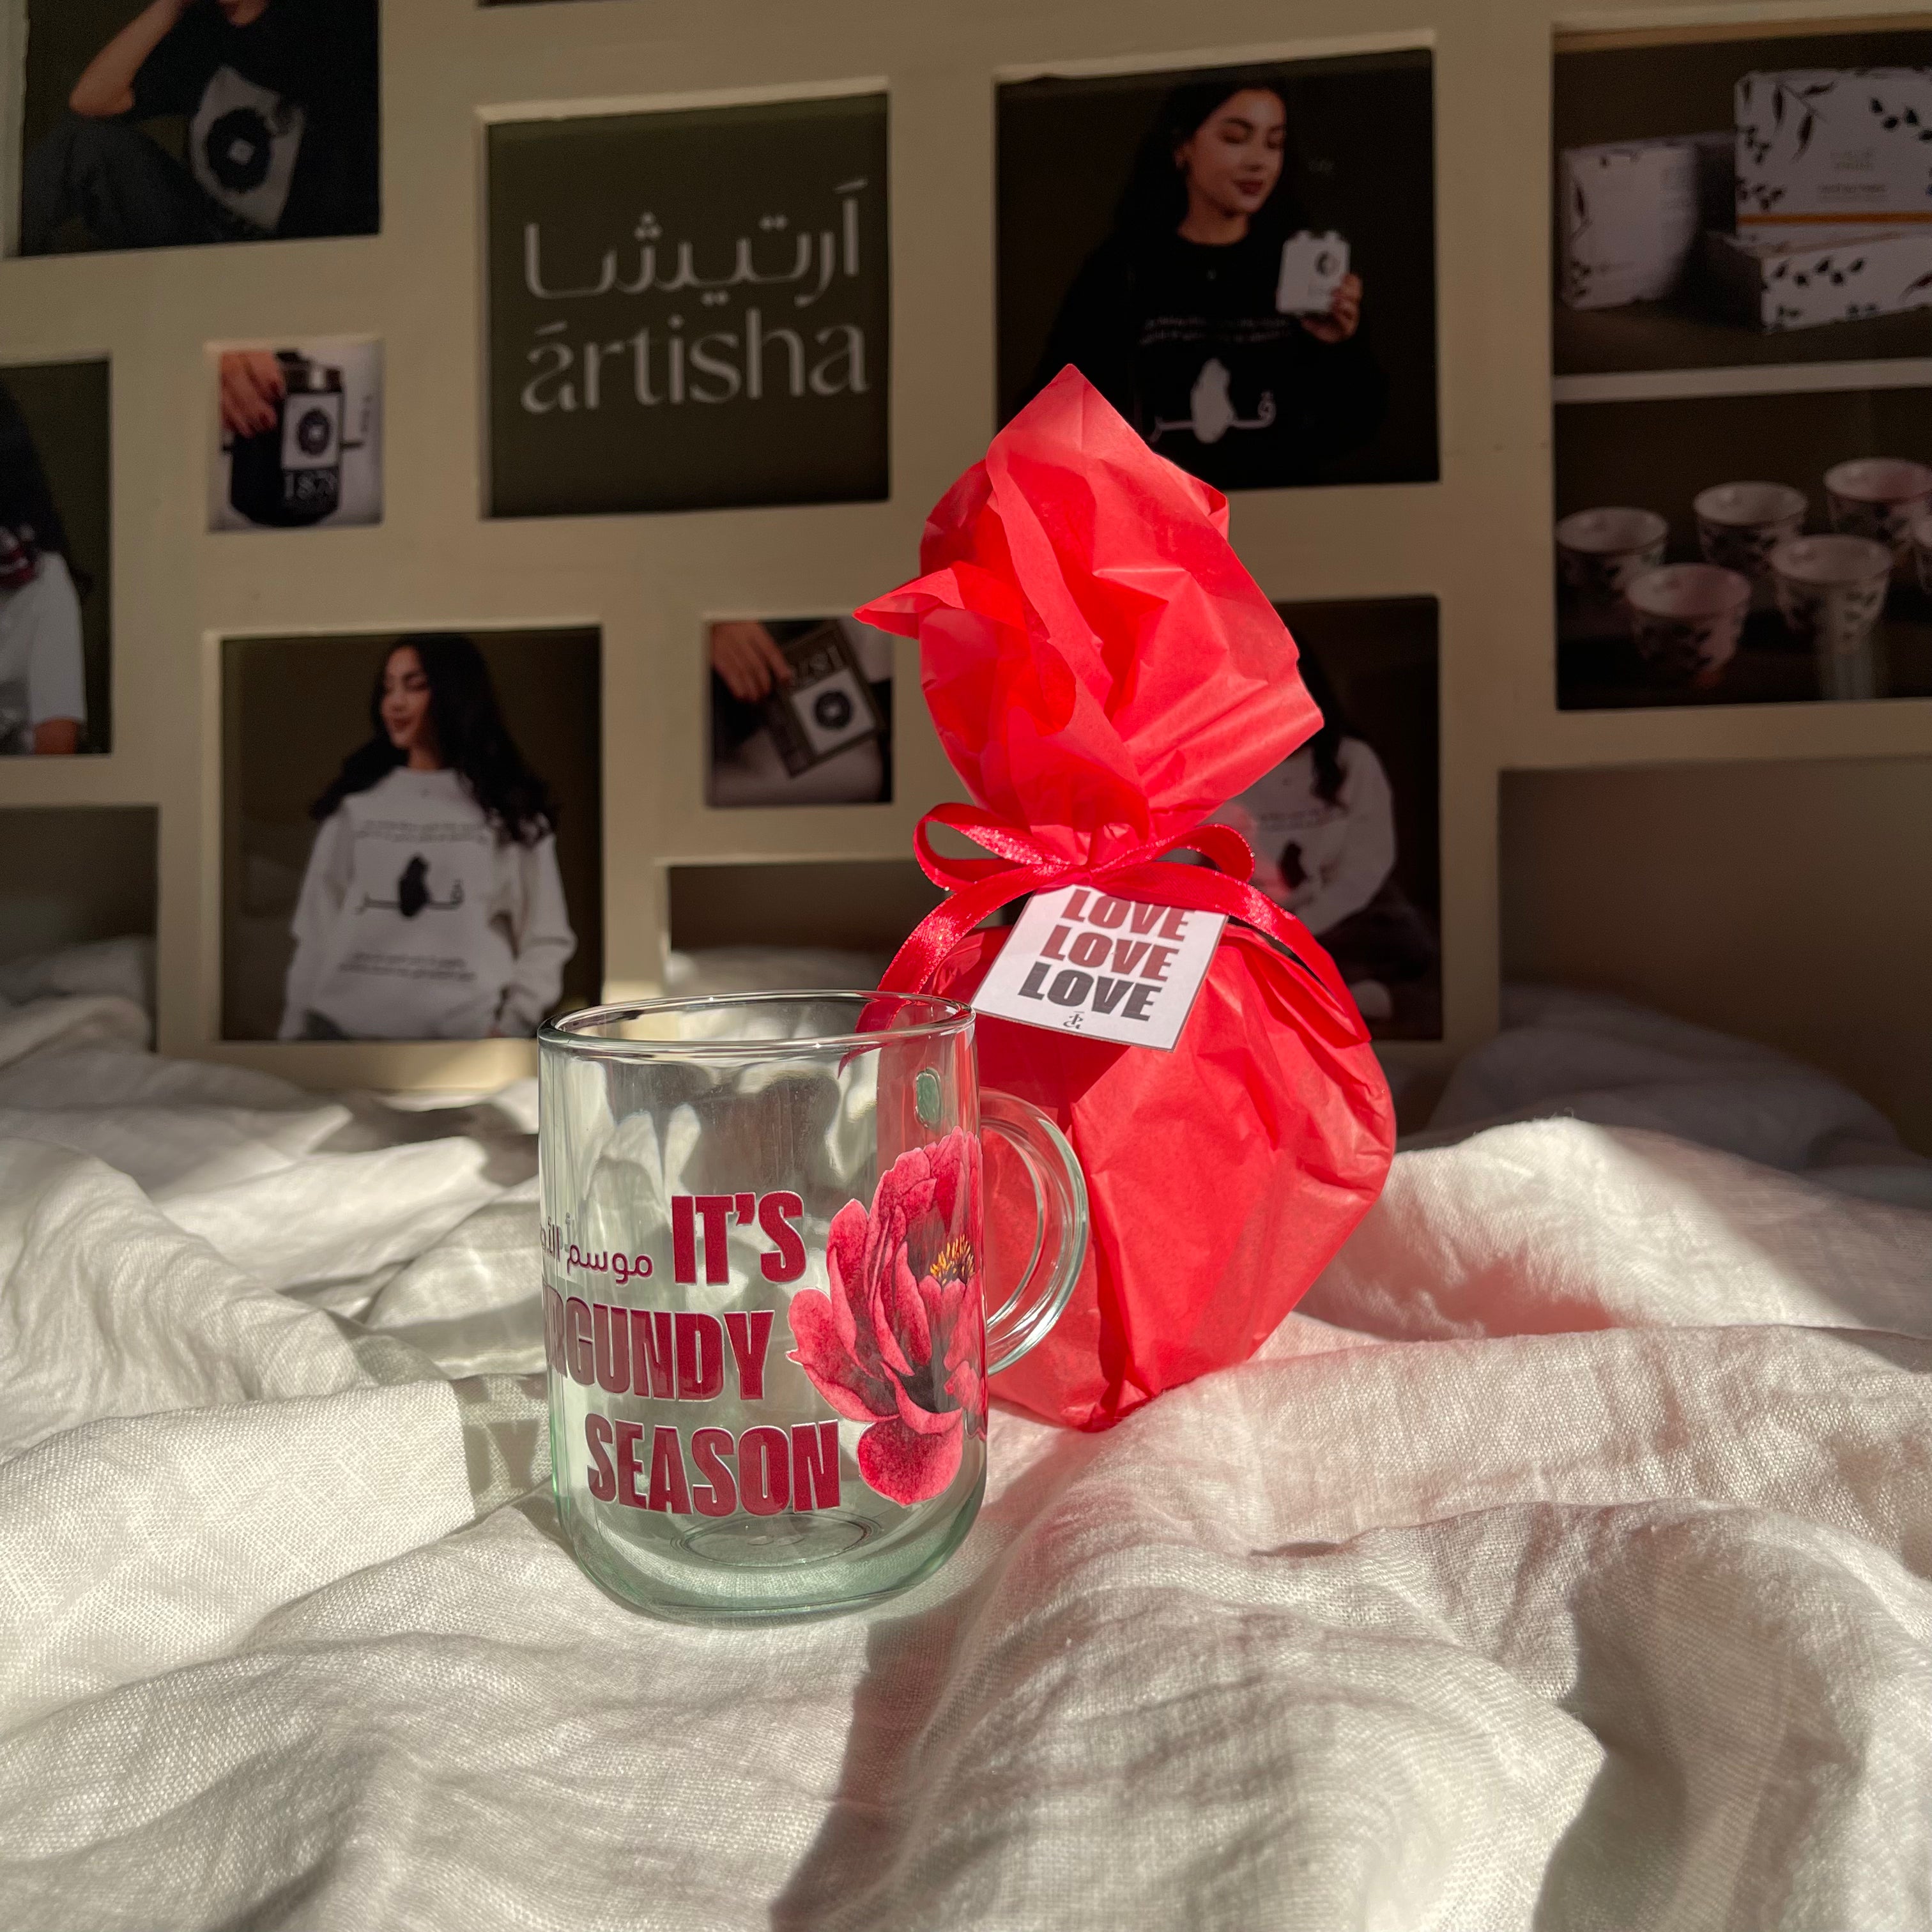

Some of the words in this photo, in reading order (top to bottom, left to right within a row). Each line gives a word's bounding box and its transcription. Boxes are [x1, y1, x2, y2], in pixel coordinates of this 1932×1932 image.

[1061, 889, 1193, 942] LOVE
[1039, 924, 1179, 983] LOVE
[1018, 961, 1163, 1022] LOVE
[566, 1244, 653, 1285] موسم
[671, 1190, 807, 1286] IT'S
[542, 1281, 776, 1402] RGUNDY
[585, 1412, 842, 1517] SEASON
